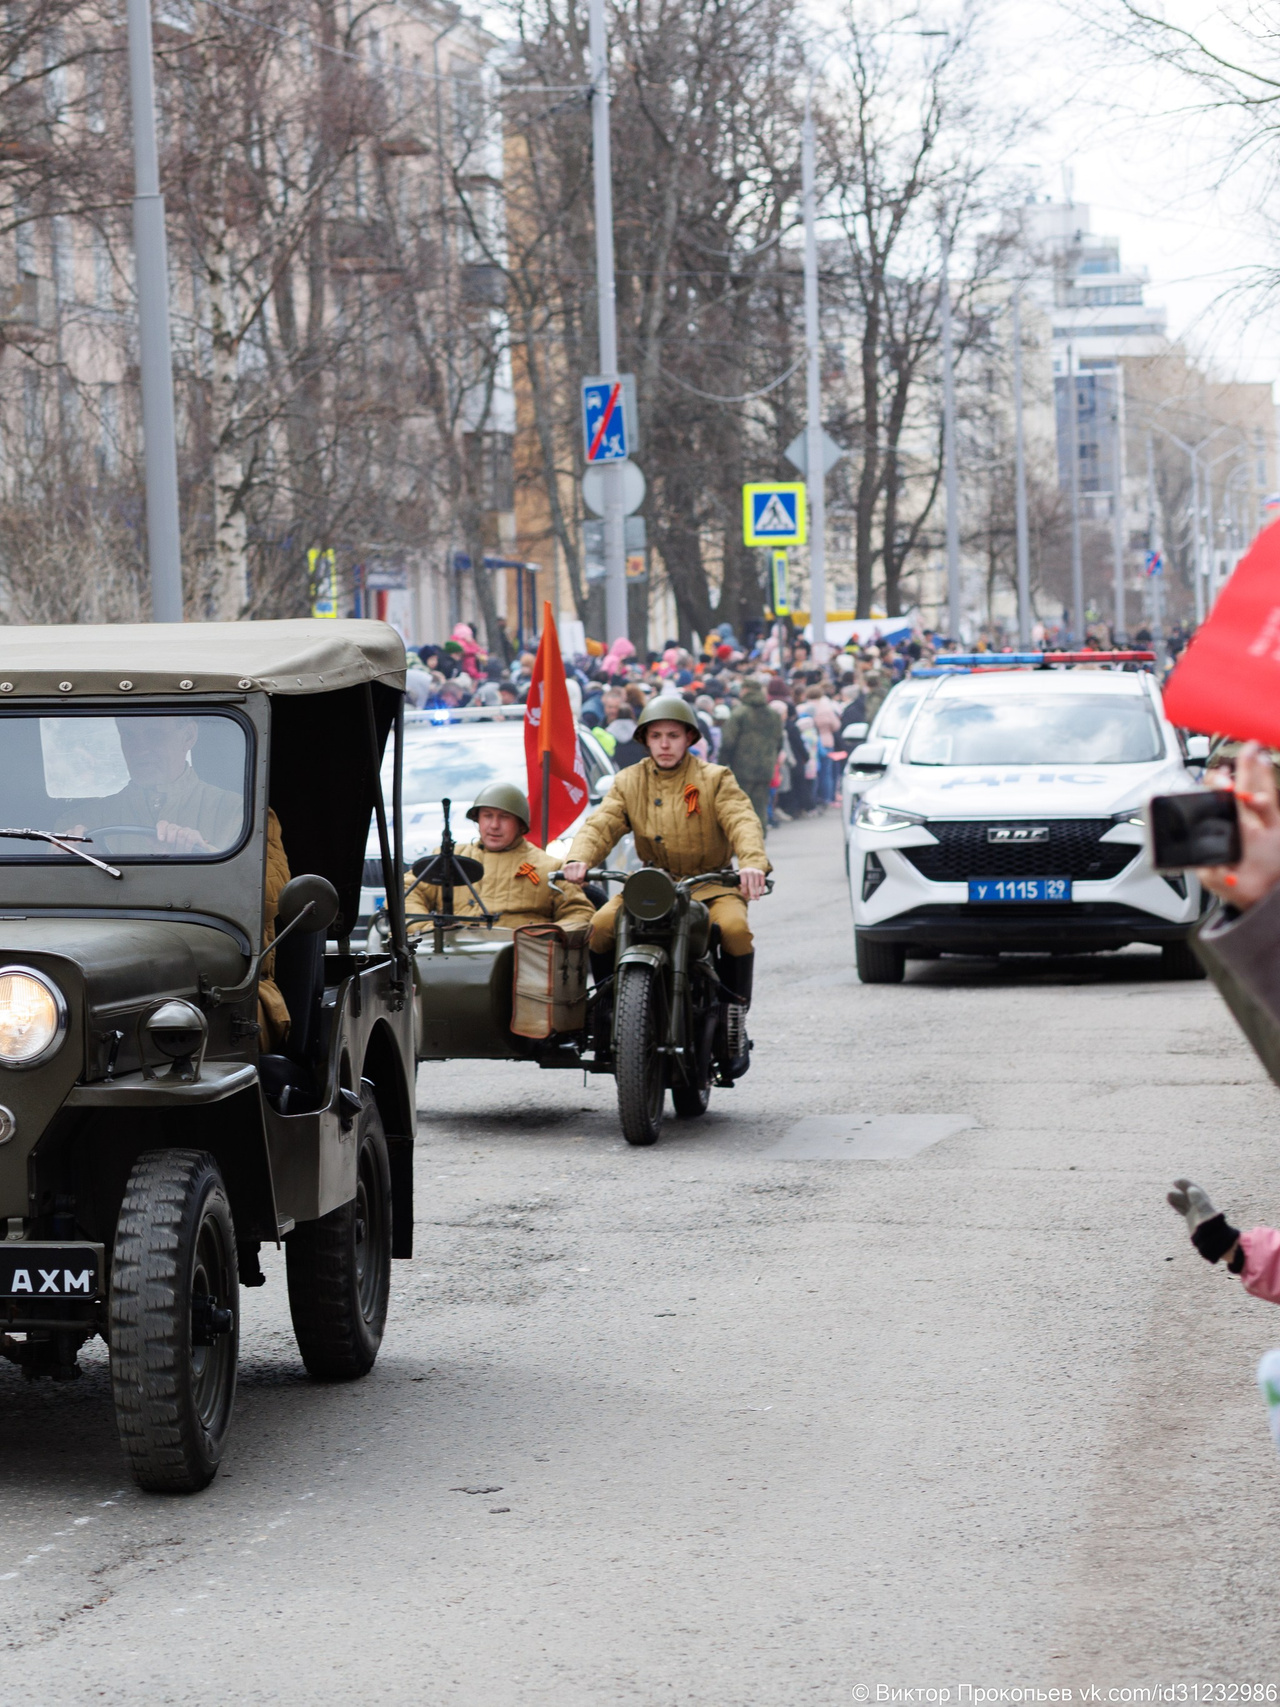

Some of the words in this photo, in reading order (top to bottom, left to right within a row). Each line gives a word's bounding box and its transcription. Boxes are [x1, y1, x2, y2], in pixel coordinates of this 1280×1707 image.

[995, 881, 1038, 899] 1115
[1048, 880, 1066, 894] 29
[10, 1268, 91, 1293] АХМ
